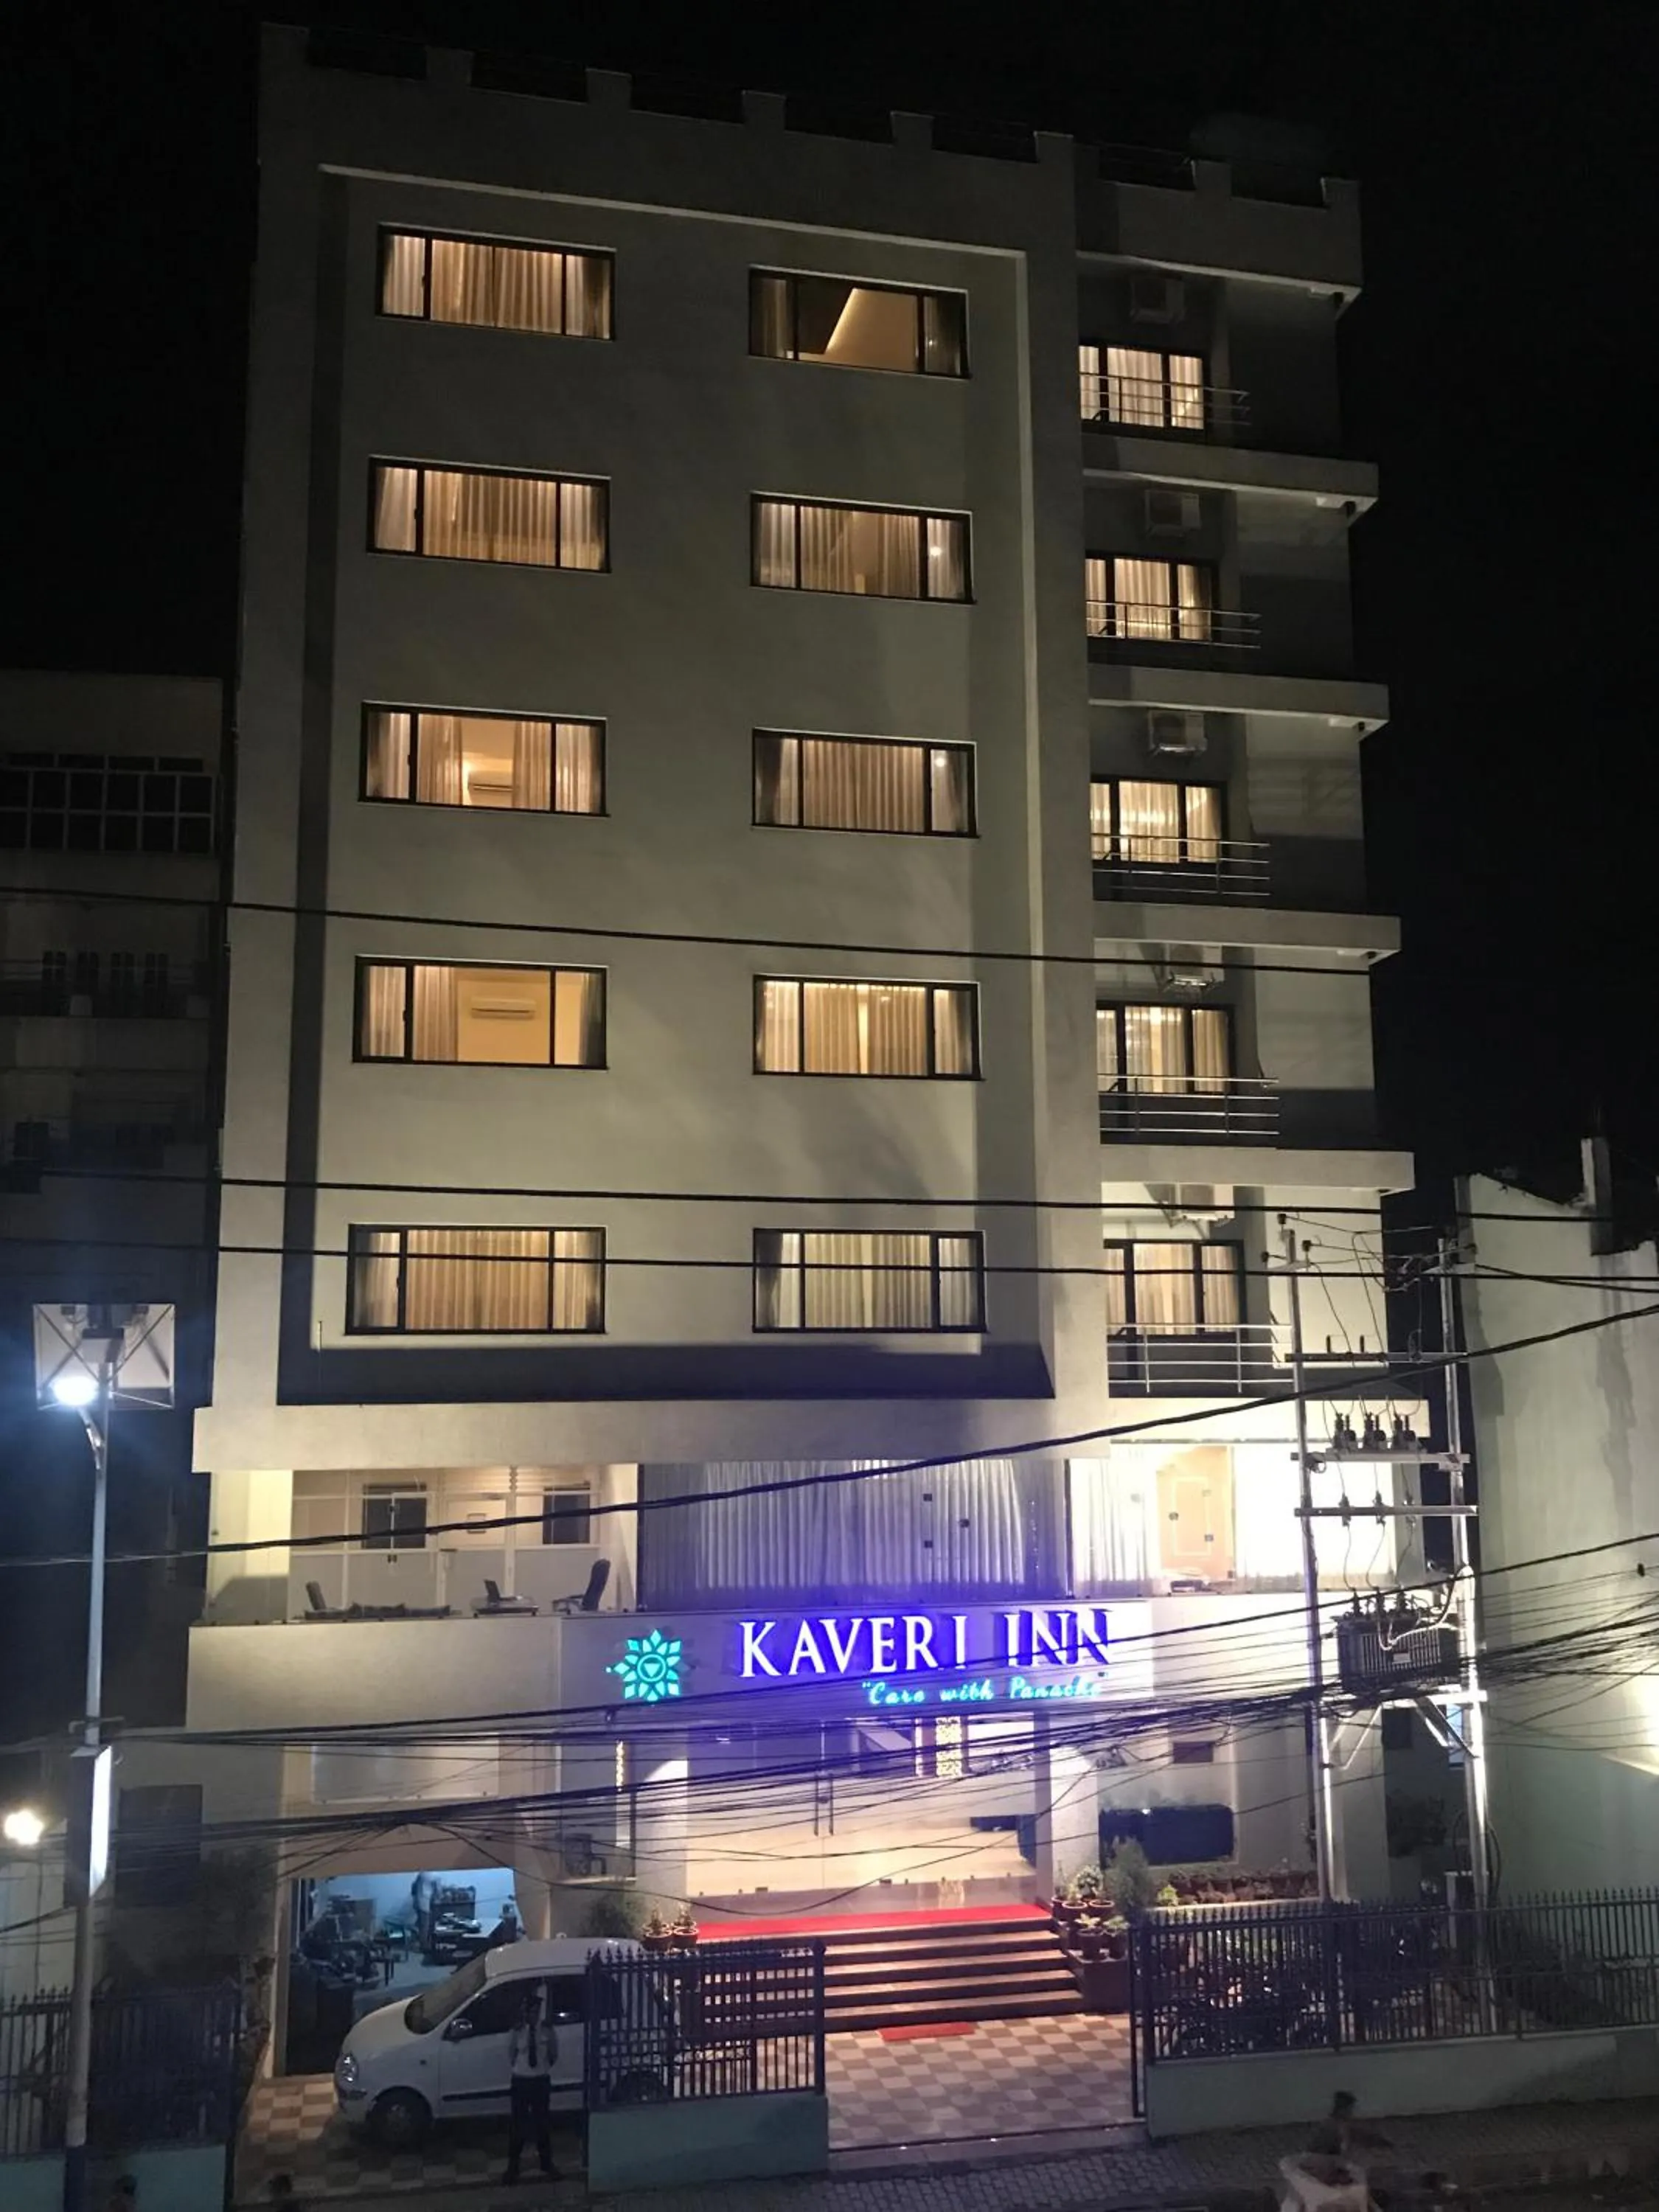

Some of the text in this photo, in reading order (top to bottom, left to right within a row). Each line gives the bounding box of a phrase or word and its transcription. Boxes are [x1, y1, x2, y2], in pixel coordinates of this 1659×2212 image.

[739, 1608, 1113, 1677] KAVERI INN
[939, 1677, 994, 1703] with
